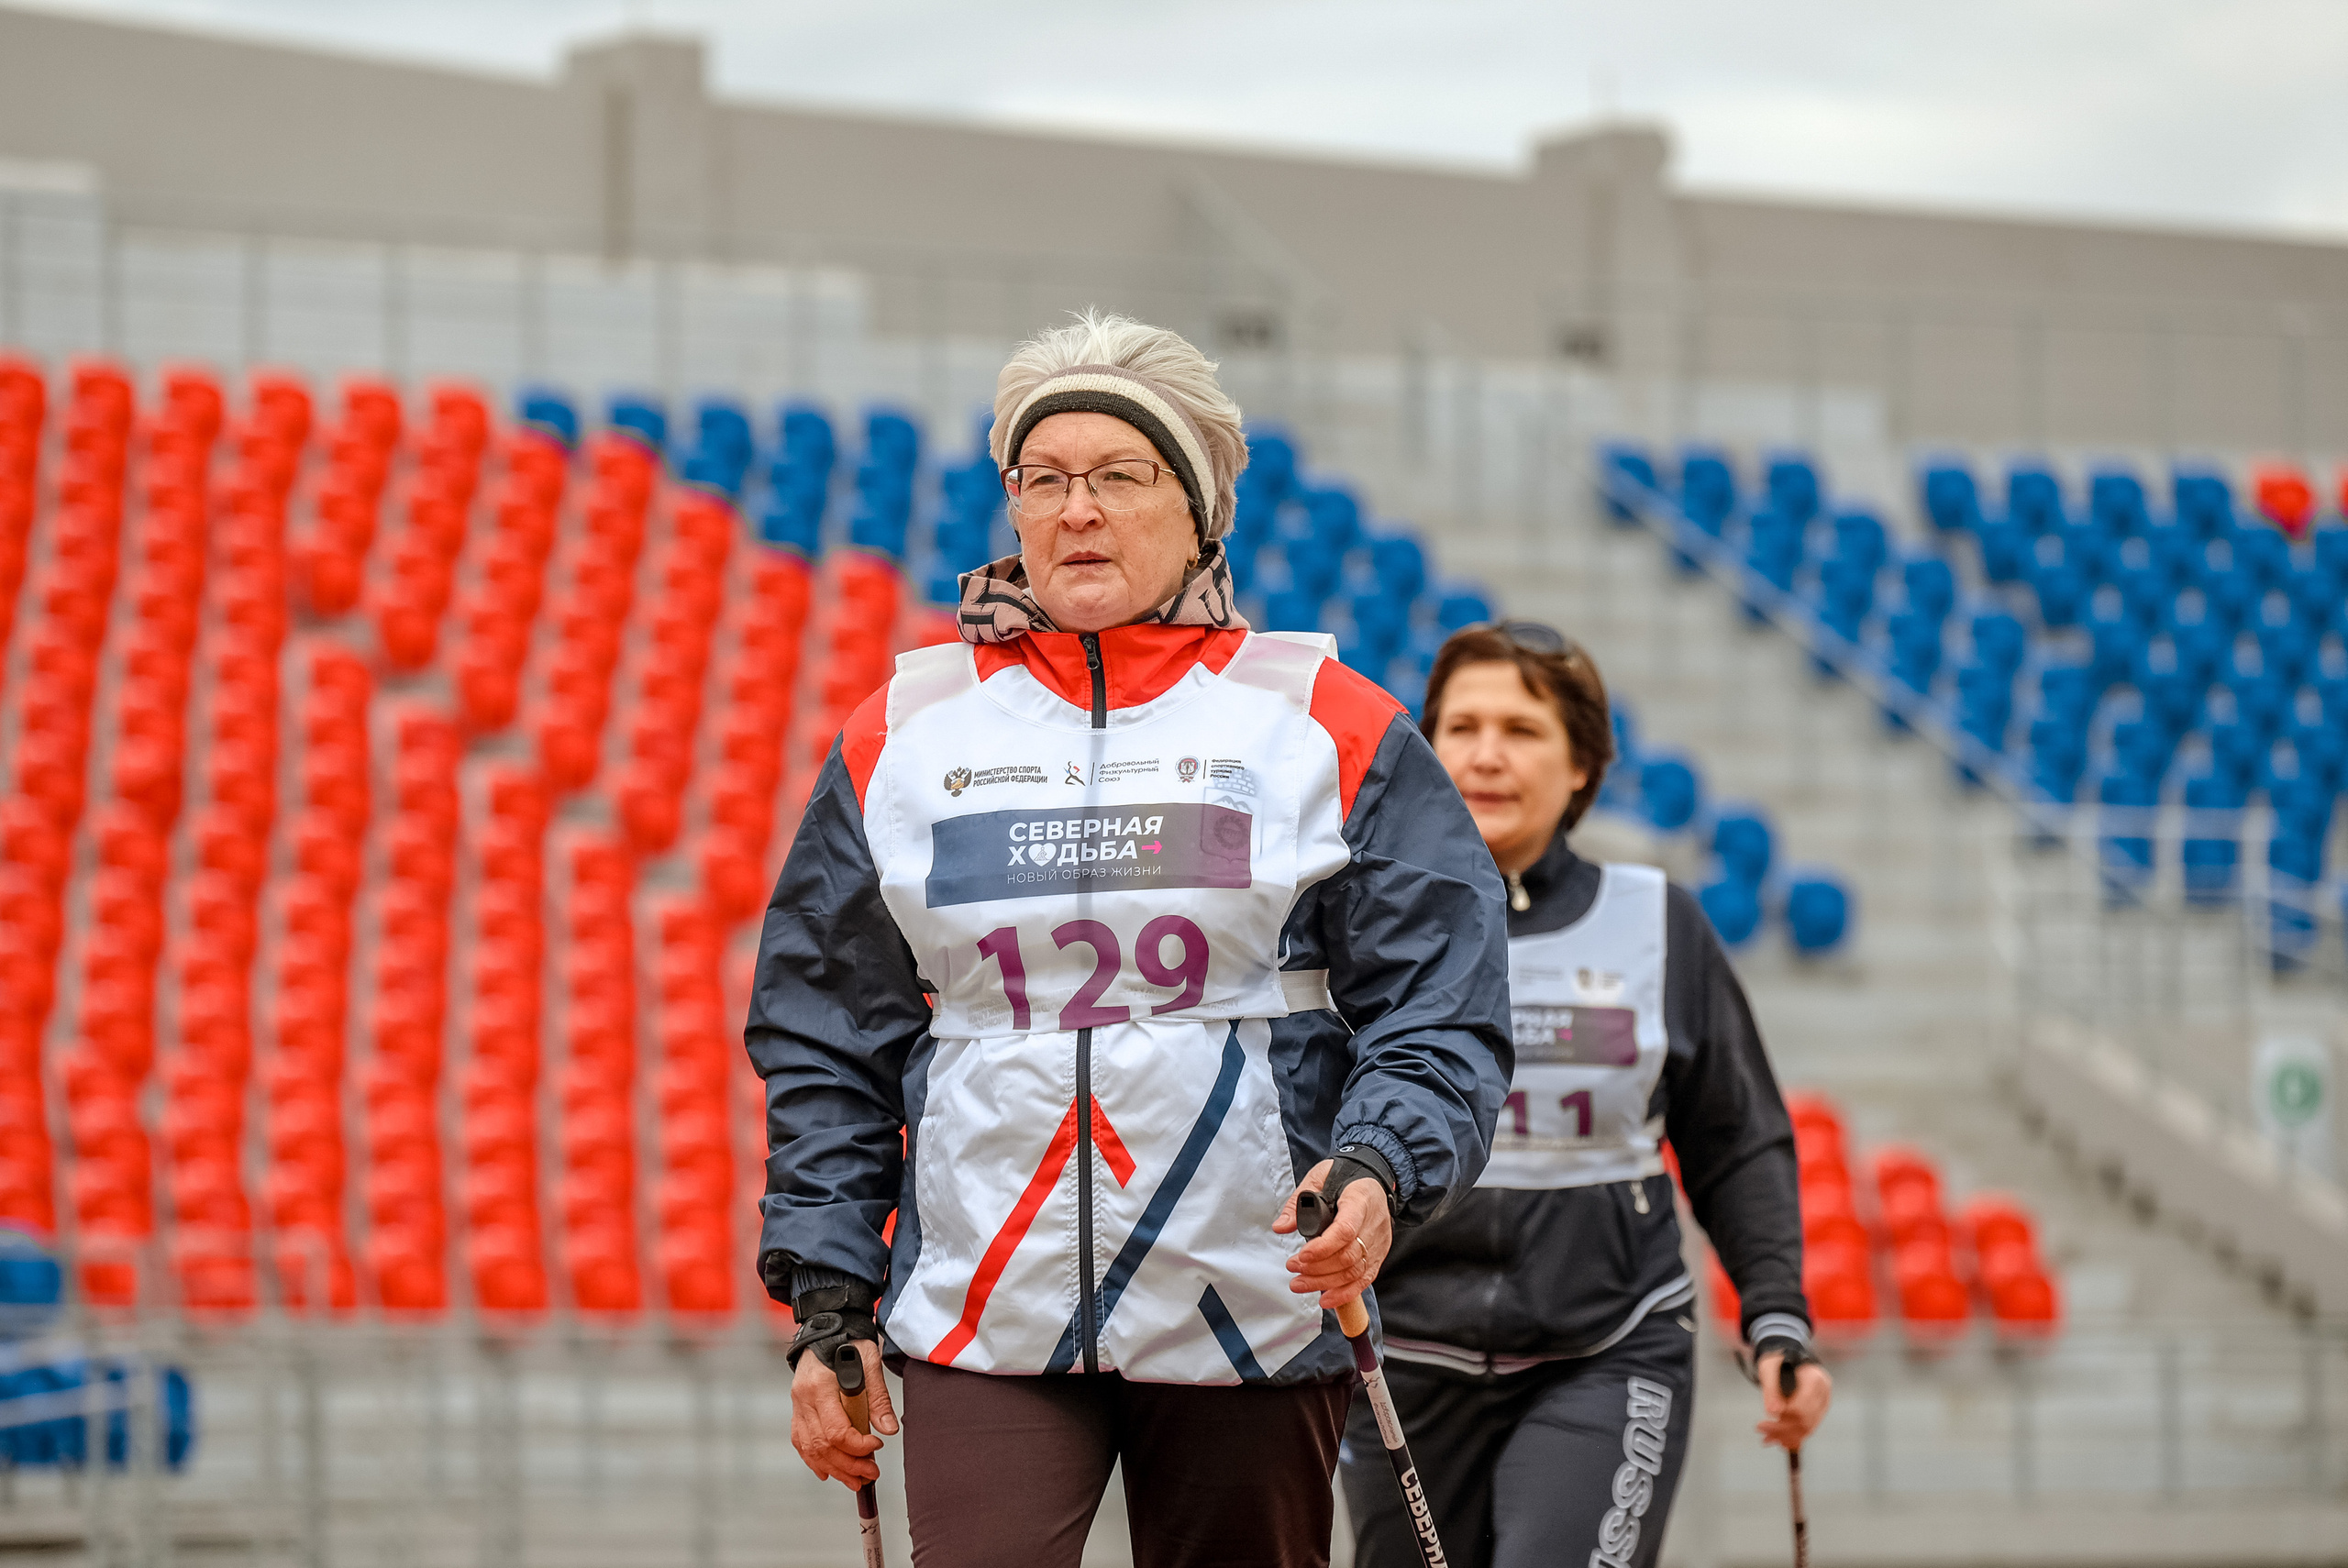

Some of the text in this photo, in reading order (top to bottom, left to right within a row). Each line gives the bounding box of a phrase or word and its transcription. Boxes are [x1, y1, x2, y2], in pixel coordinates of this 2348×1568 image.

[973, 766, 1042, 778] МИНИСТЕРСТВО СПОРТА
[1100, 758, 1159, 769] Добровольный
[973, 774, 1048, 787] РОССИЙСКОЙ ФЕДЕРАЦИИ
[1009, 815, 1164, 842] СЕВЕРНАЯ
[1007, 865, 1162, 884] НОВЫЙ ОБРАЗ ЖИЗНИ
[976, 914, 1210, 1030] 129
[1401, 1466, 1449, 1568] СЕВЕРН
